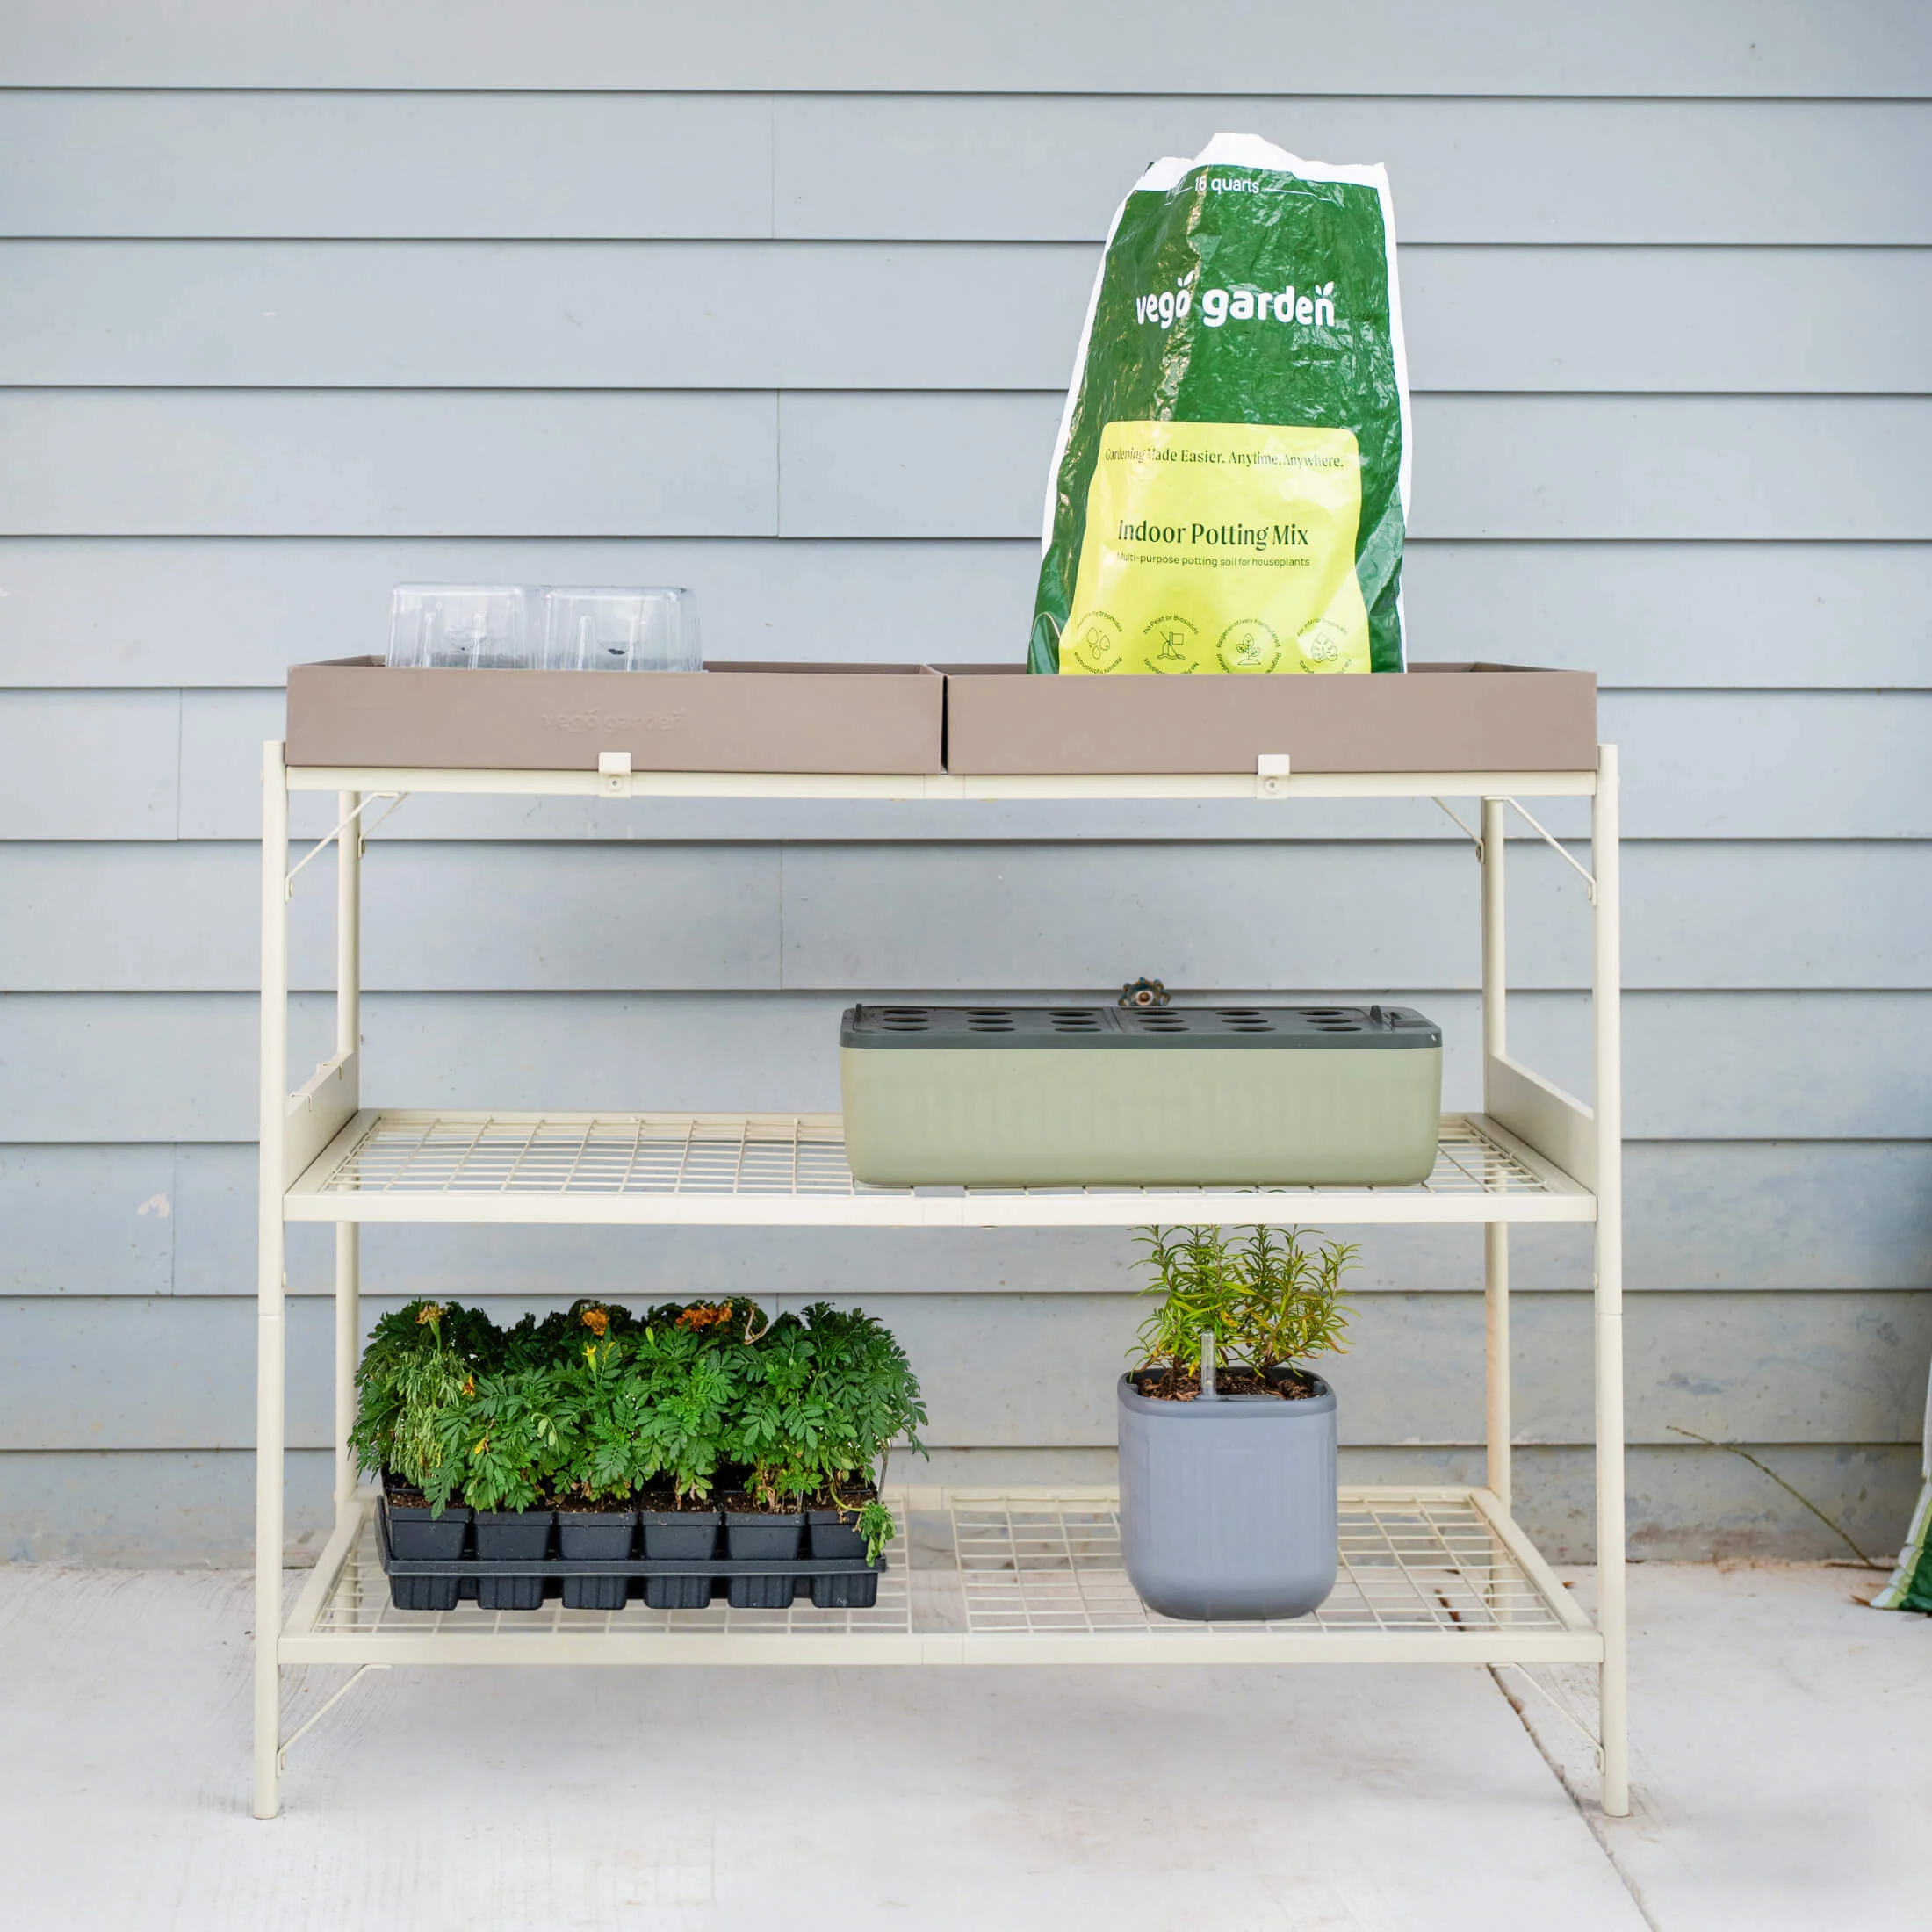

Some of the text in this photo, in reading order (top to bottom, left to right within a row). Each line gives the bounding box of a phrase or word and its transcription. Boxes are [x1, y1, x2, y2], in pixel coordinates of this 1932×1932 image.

[1193, 177, 1260, 195] 16 quarts
[1136, 274, 1335, 329] vego garden
[1105, 446, 1145, 464] Gardening
[1181, 449, 1226, 464] Easier.
[1118, 519, 1309, 551] Indoor Potting Mix
[1116, 551, 1310, 569] Multi-purpose potting soil for houseplants
